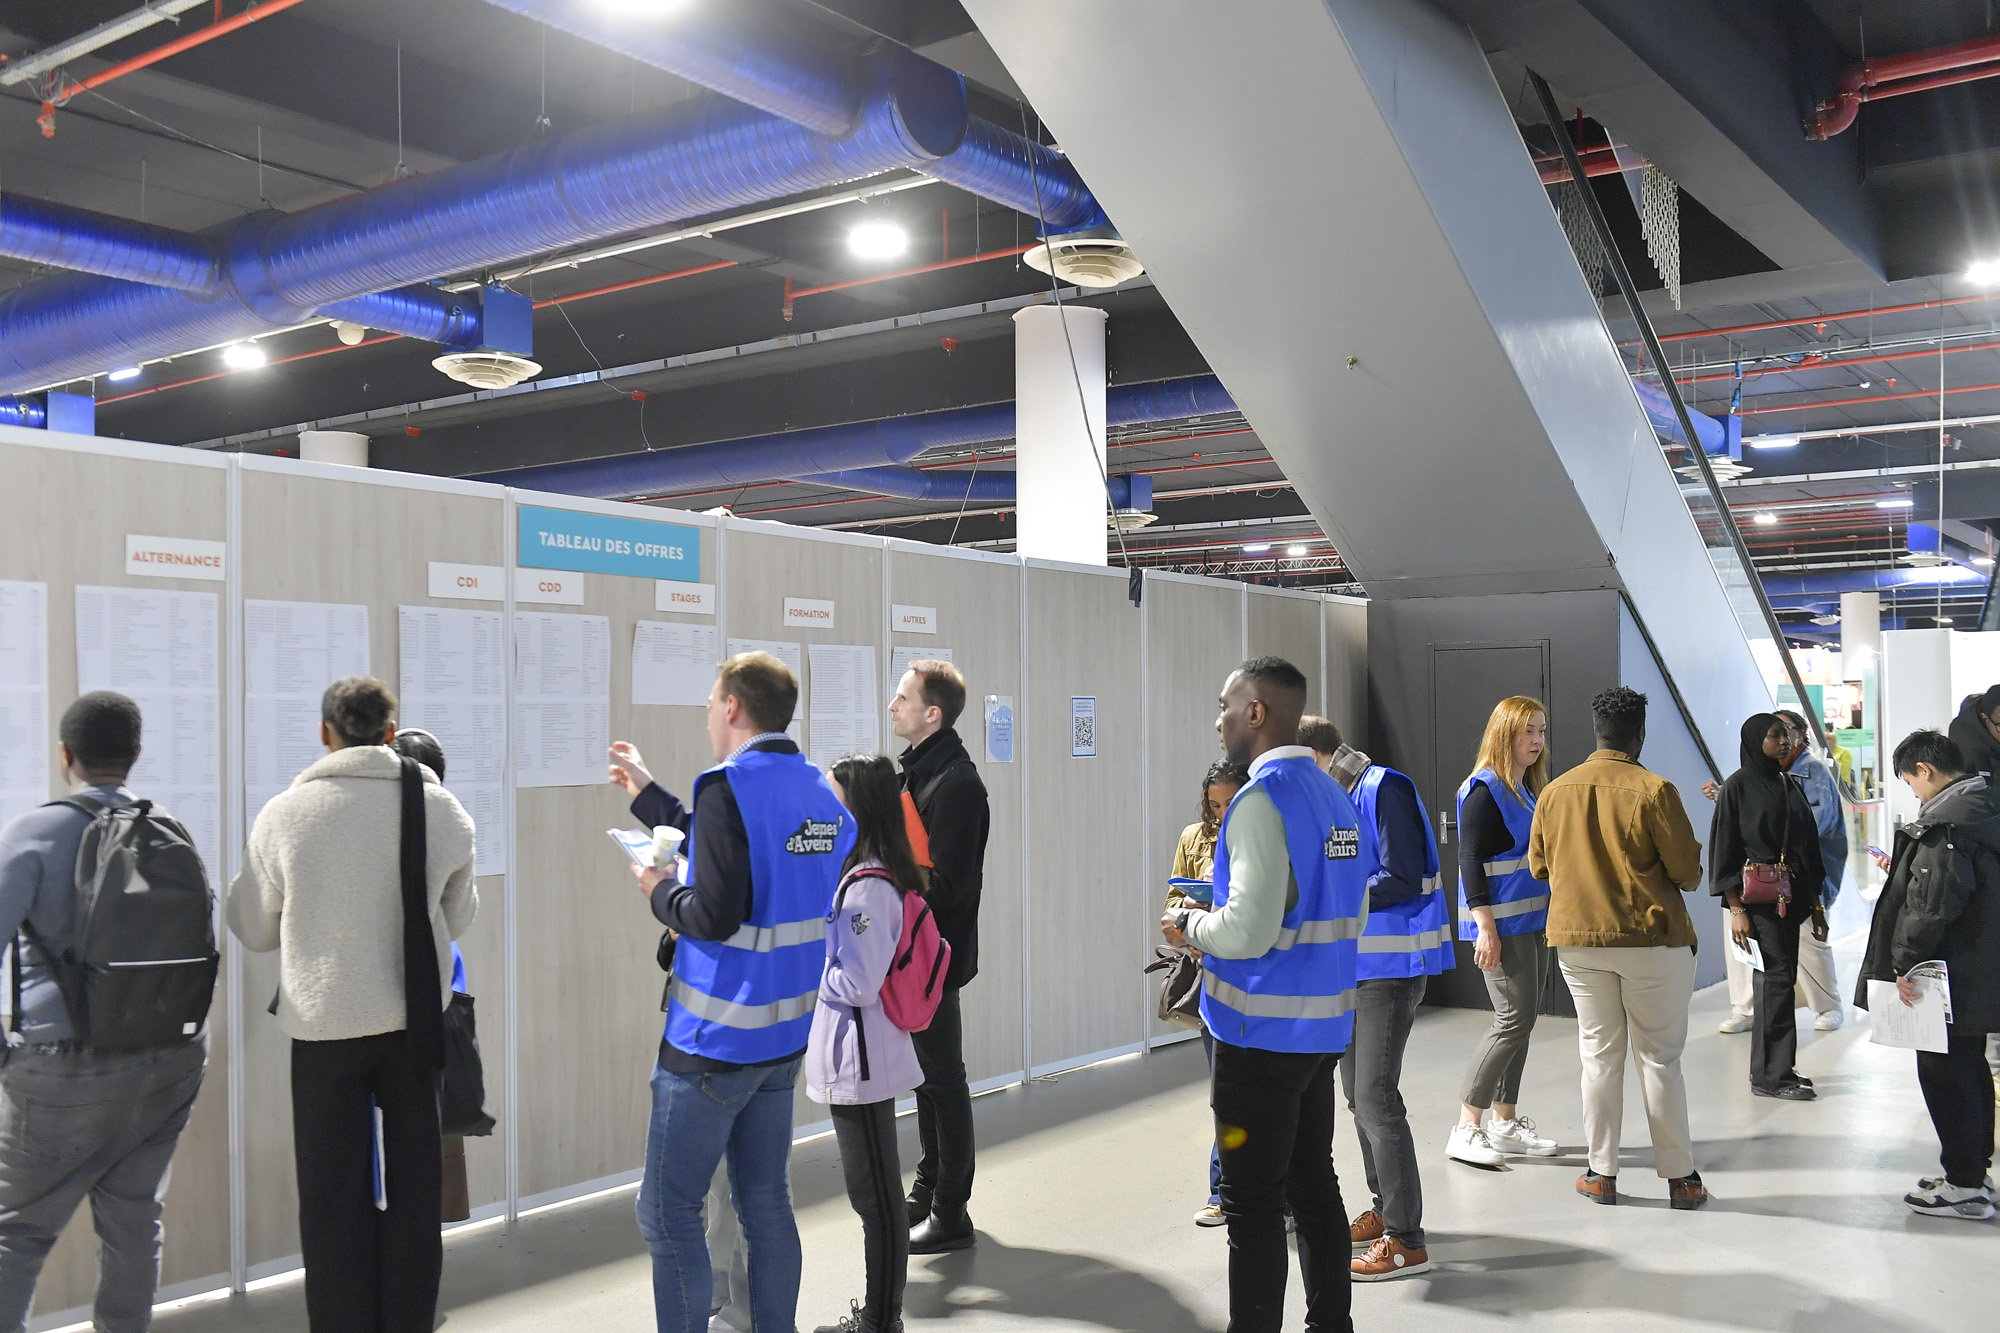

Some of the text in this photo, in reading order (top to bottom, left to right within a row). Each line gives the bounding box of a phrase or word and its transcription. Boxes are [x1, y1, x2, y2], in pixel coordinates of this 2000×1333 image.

[538, 531, 684, 560] TABLEAU DES OFFRES
[132, 551, 221, 567] ALTERNANCE
[457, 576, 478, 588] CDI
[538, 582, 562, 593] CDD
[671, 593, 701, 604] STAGES
[789, 608, 830, 619] FORMATION
[903, 616, 926, 625] AUTRES
